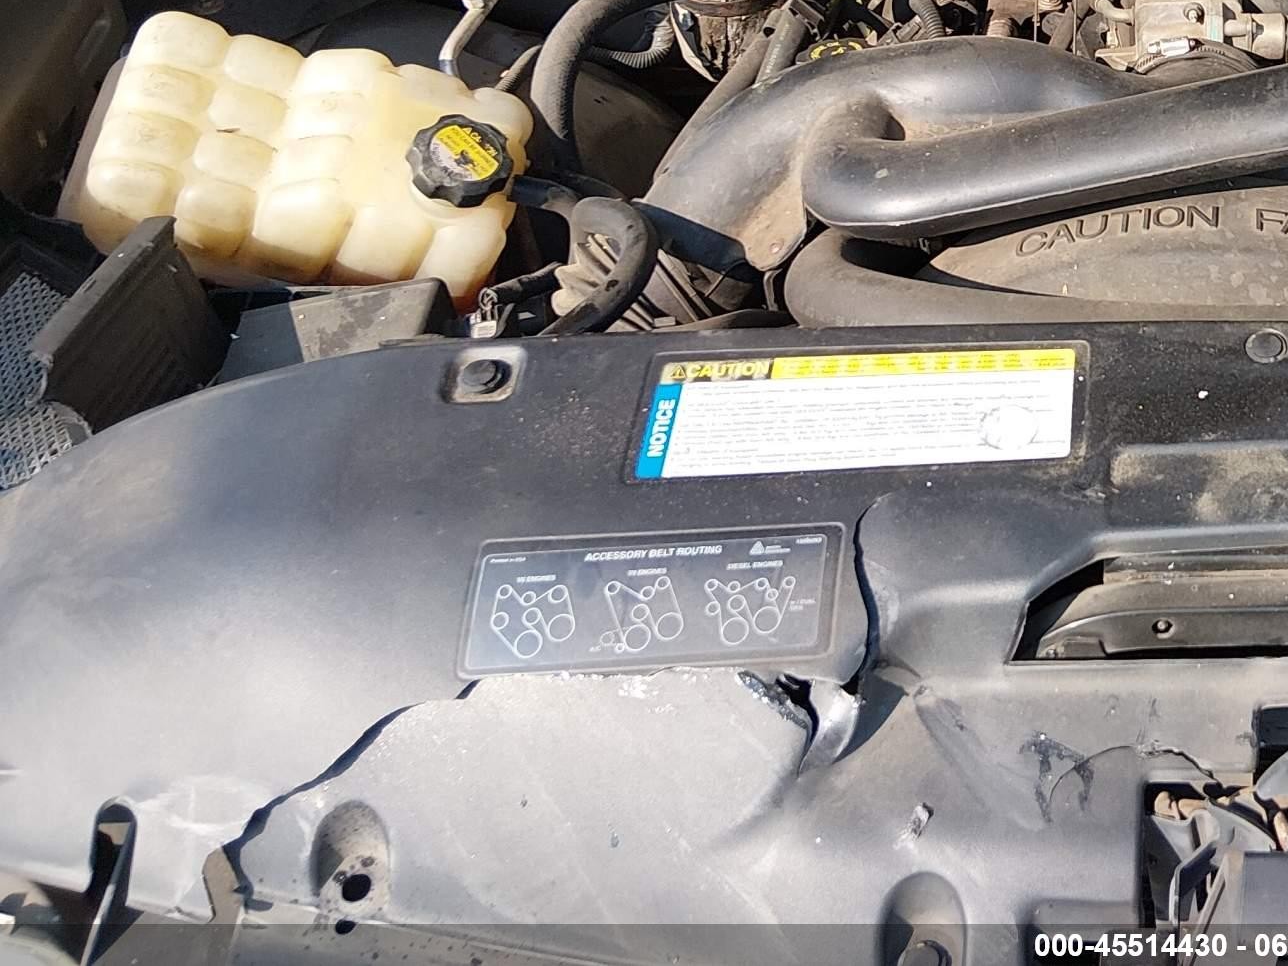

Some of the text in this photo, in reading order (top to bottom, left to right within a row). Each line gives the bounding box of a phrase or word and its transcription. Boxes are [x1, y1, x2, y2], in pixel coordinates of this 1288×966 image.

[1014, 204, 1220, 258] CAUTION
[686, 360, 771, 378] CAUTION
[646, 398, 676, 458] NOTICE
[584, 544, 723, 562] ACCESSORY BELT ROUTING
